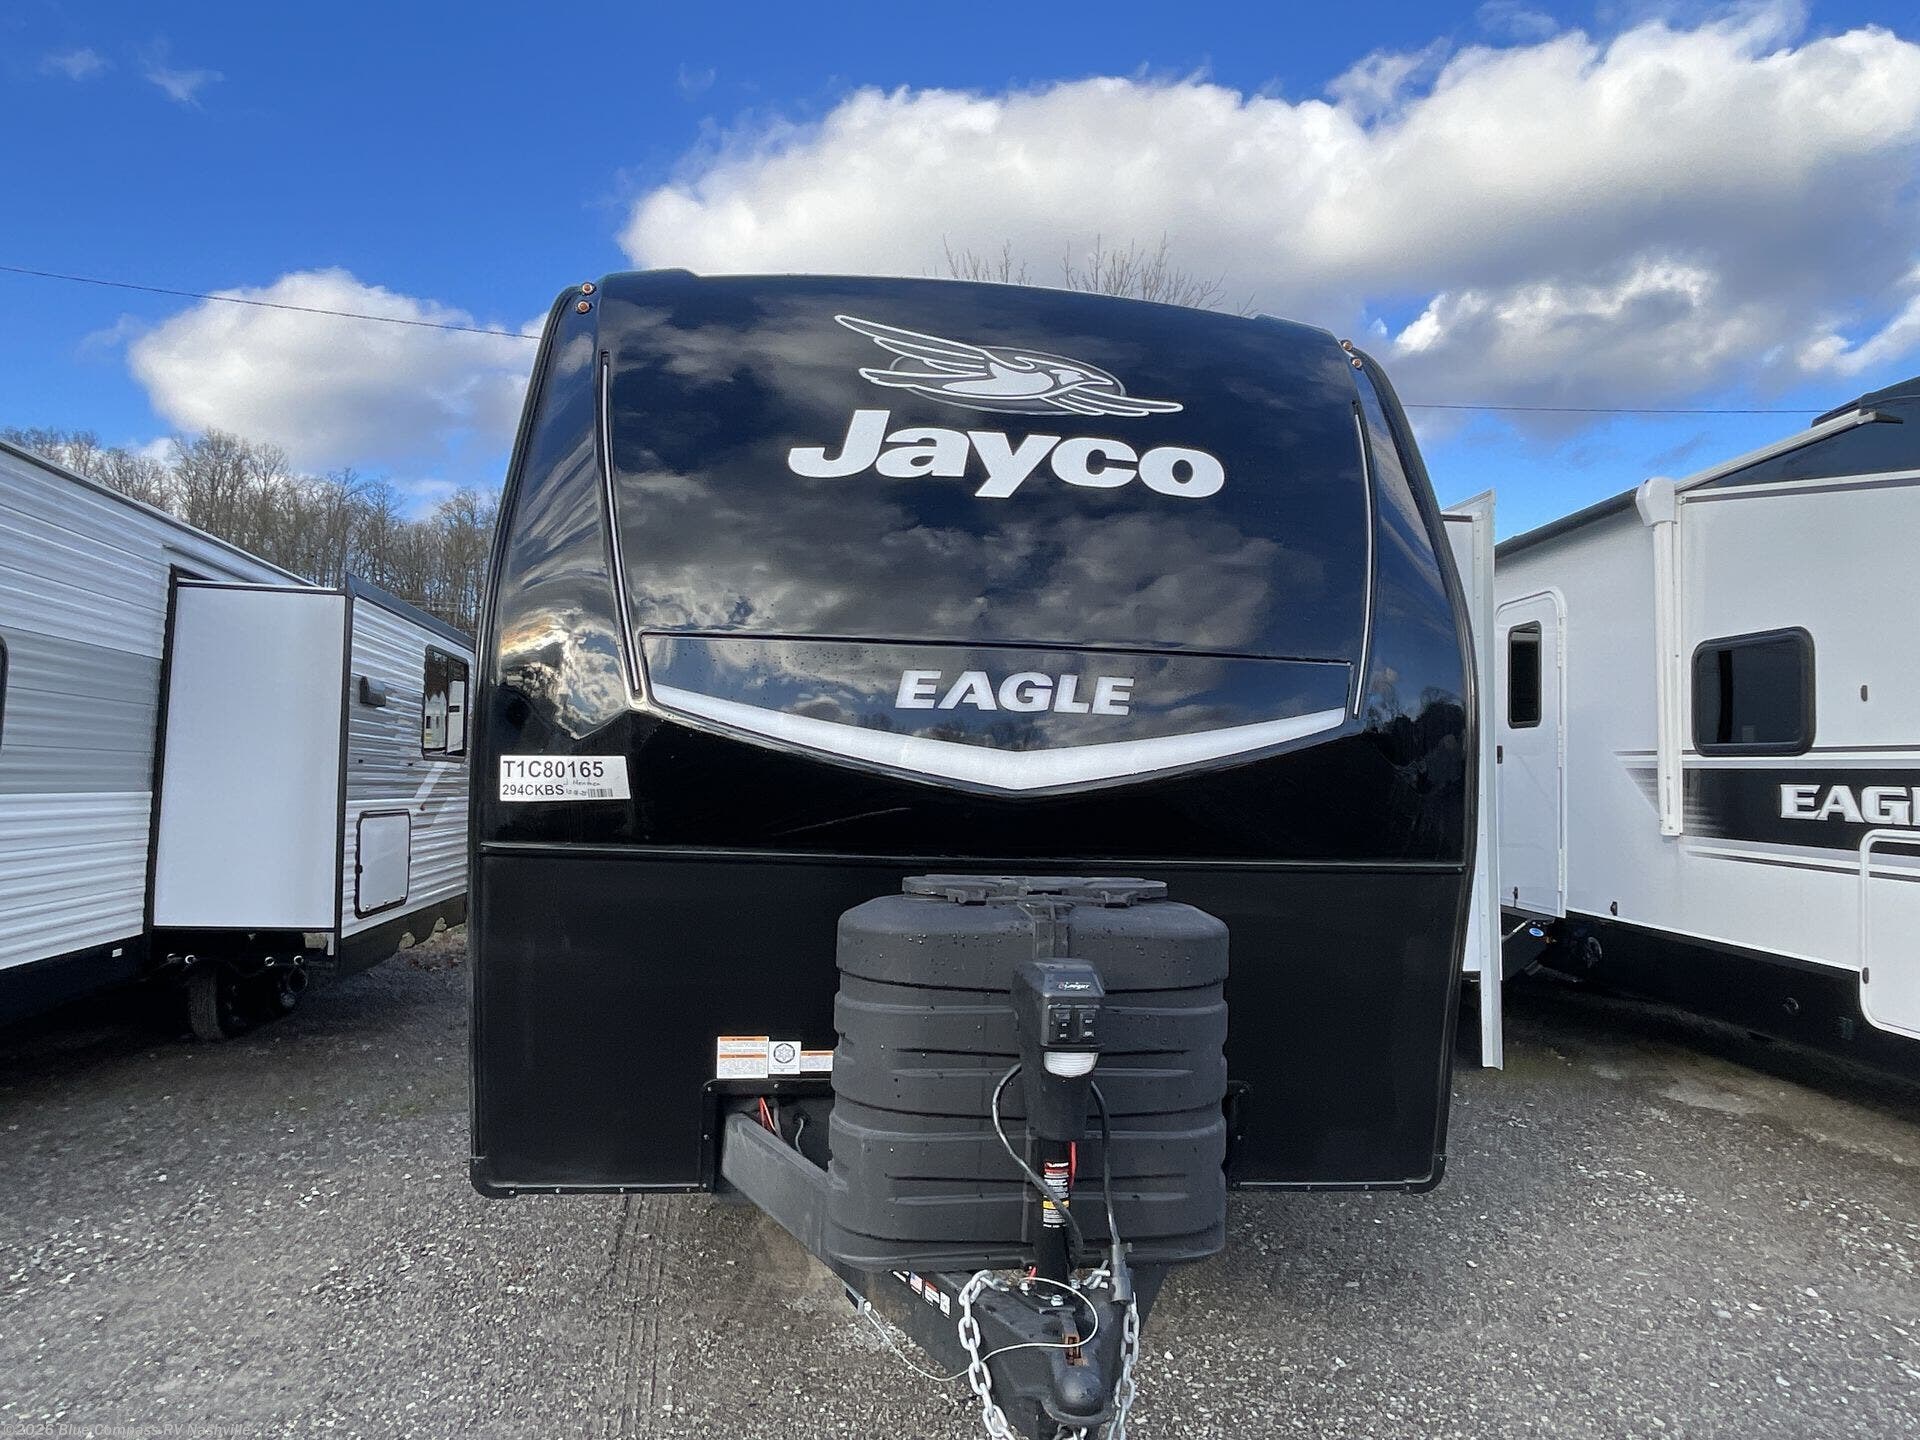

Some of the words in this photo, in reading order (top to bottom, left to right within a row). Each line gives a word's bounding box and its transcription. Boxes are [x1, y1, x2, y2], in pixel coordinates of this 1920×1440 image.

[788, 410, 1225, 498] Jayco
[894, 669, 1135, 716] EAGLE
[502, 784, 565, 796] 294CKBS
[503, 760, 604, 778] T1C80165
[1780, 784, 1920, 826] EAG
